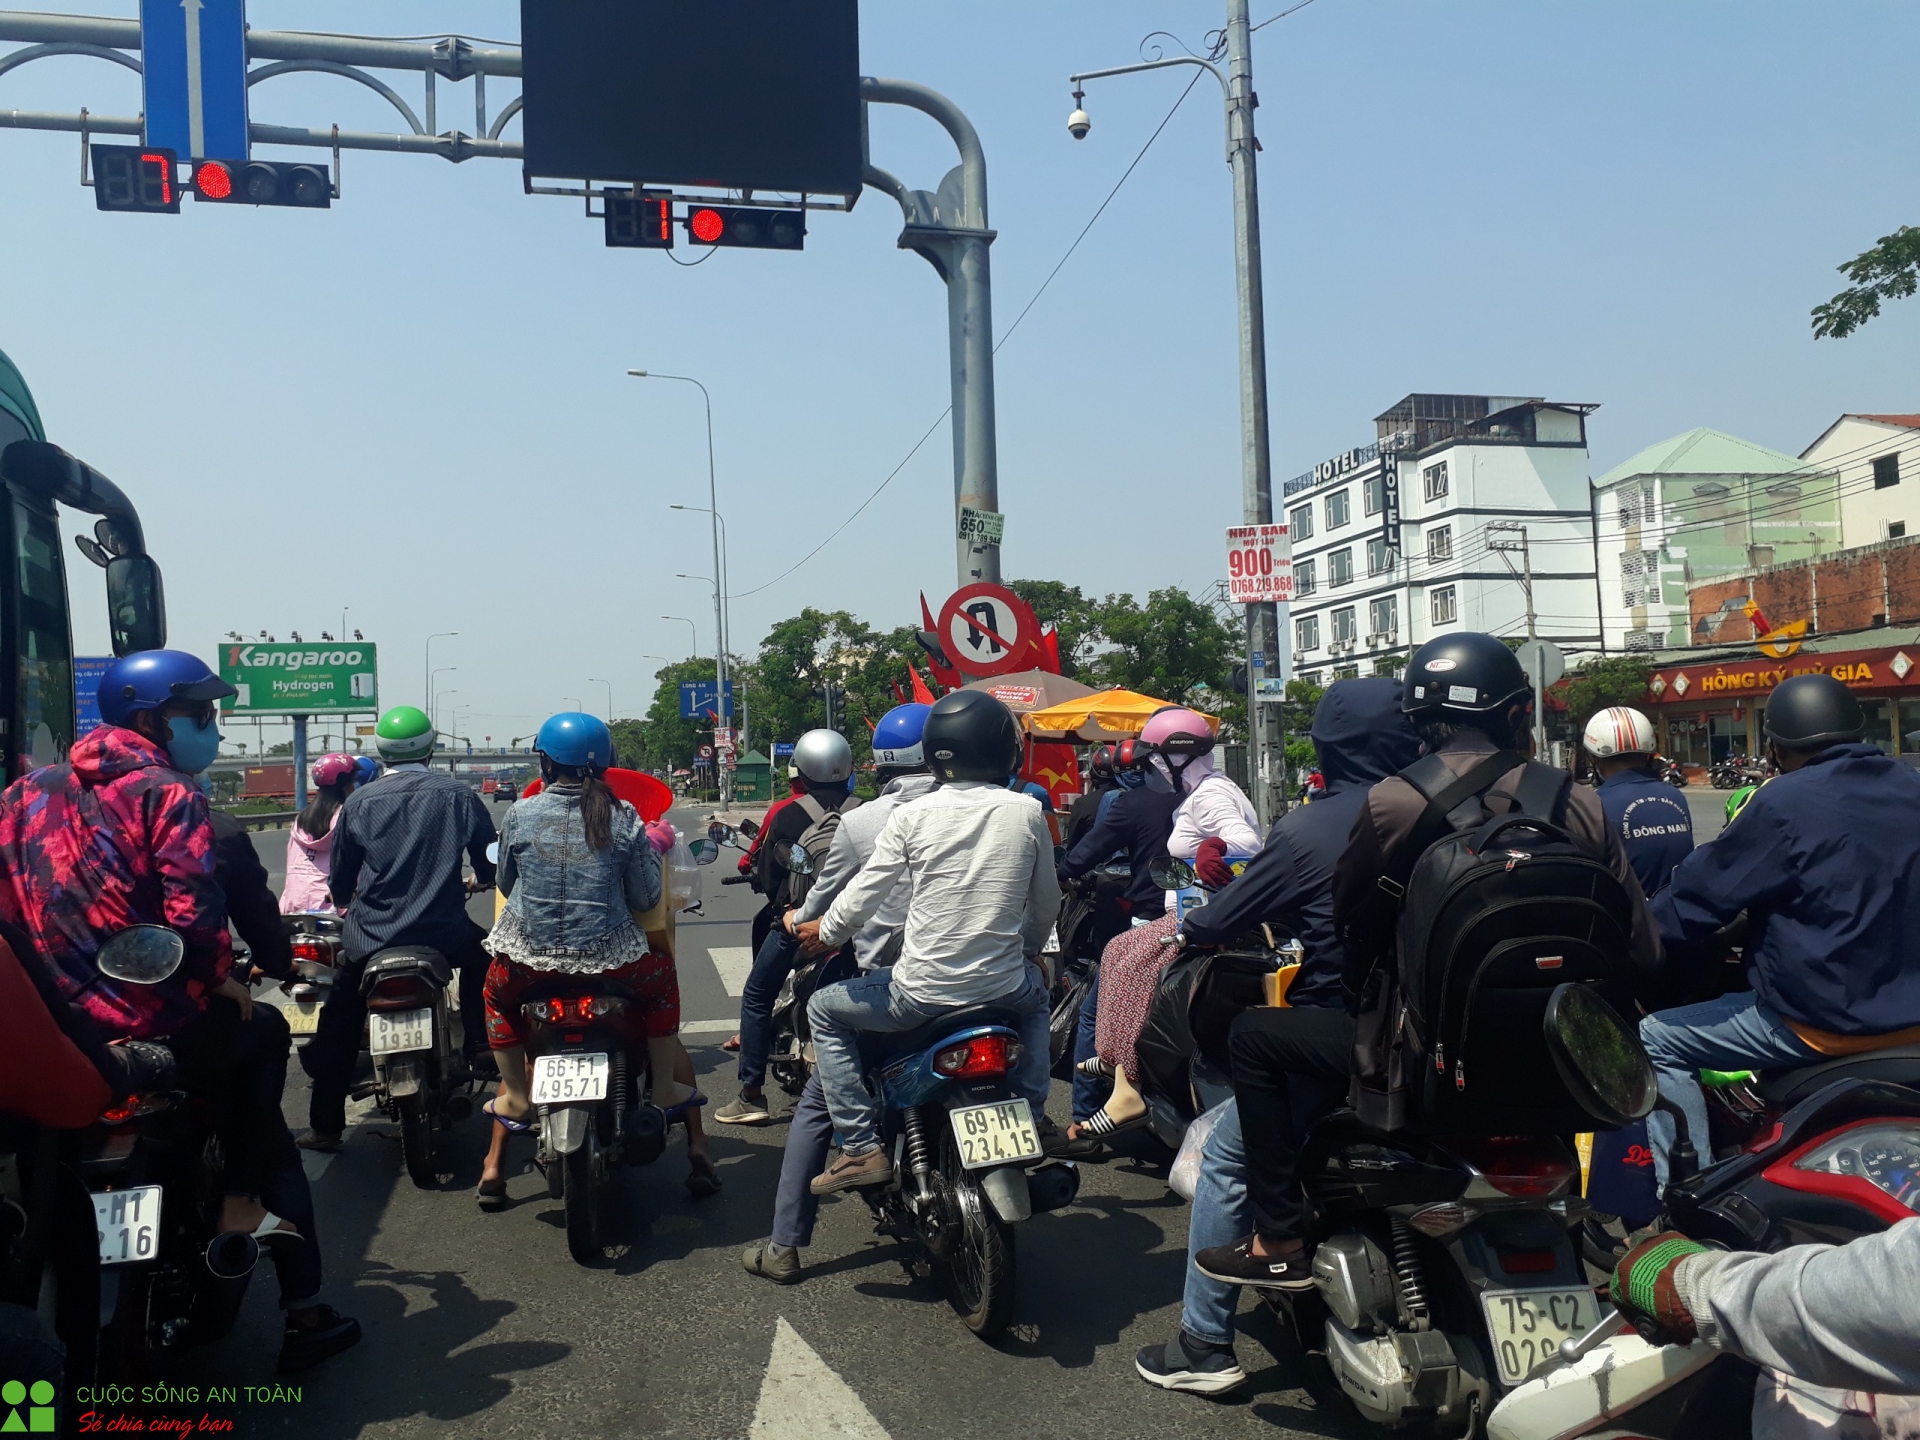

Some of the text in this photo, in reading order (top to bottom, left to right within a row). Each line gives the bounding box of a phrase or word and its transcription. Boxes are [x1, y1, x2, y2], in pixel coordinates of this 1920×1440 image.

[141, 153, 171, 204] 7
[1313, 449, 1359, 485] HOTEL
[1384, 453, 1399, 543] HOTEL
[961, 517, 984, 534] 650
[1229, 547, 1273, 578] 900
[1231, 576, 1293, 594] 0768.219.868
[273, 679, 334, 693] Hydrogen
[1702, 667, 1756, 692] HỒNG
[1831, 662, 1873, 682] GIA
[1633, 824, 1688, 838] ĐÔNG NAM
[380, 1030, 423, 1050] 1938
[546, 1056, 594, 1078] 66-F1
[539, 1077, 600, 1099] 495.71
[963, 1104, 1020, 1136] 69-H1
[963, 1129, 1036, 1164] 234.15
[1500, 1294, 1585, 1334] 75-C2
[1341, 1370, 1367, 1394] HONDA
